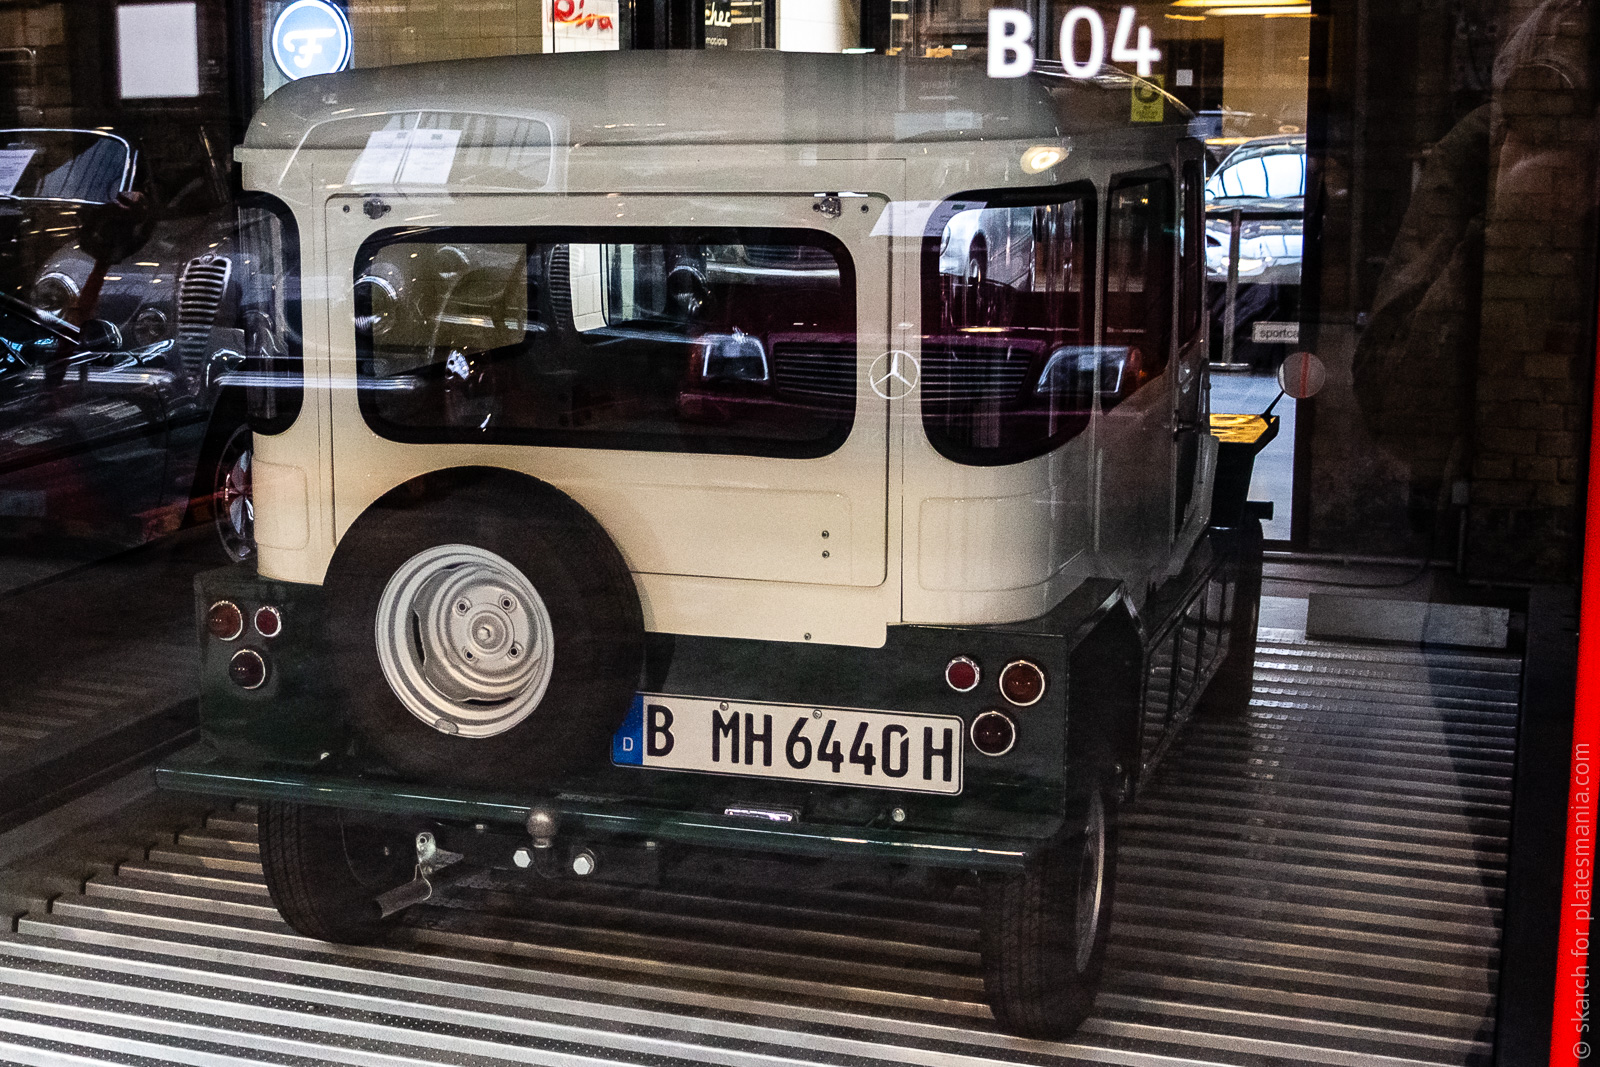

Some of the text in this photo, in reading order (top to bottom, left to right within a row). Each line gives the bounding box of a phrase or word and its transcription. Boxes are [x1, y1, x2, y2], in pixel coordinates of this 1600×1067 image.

[987, 6, 1162, 79] B 04
[622, 736, 634, 752] D
[647, 704, 675, 757] B
[712, 709, 773, 767] MH
